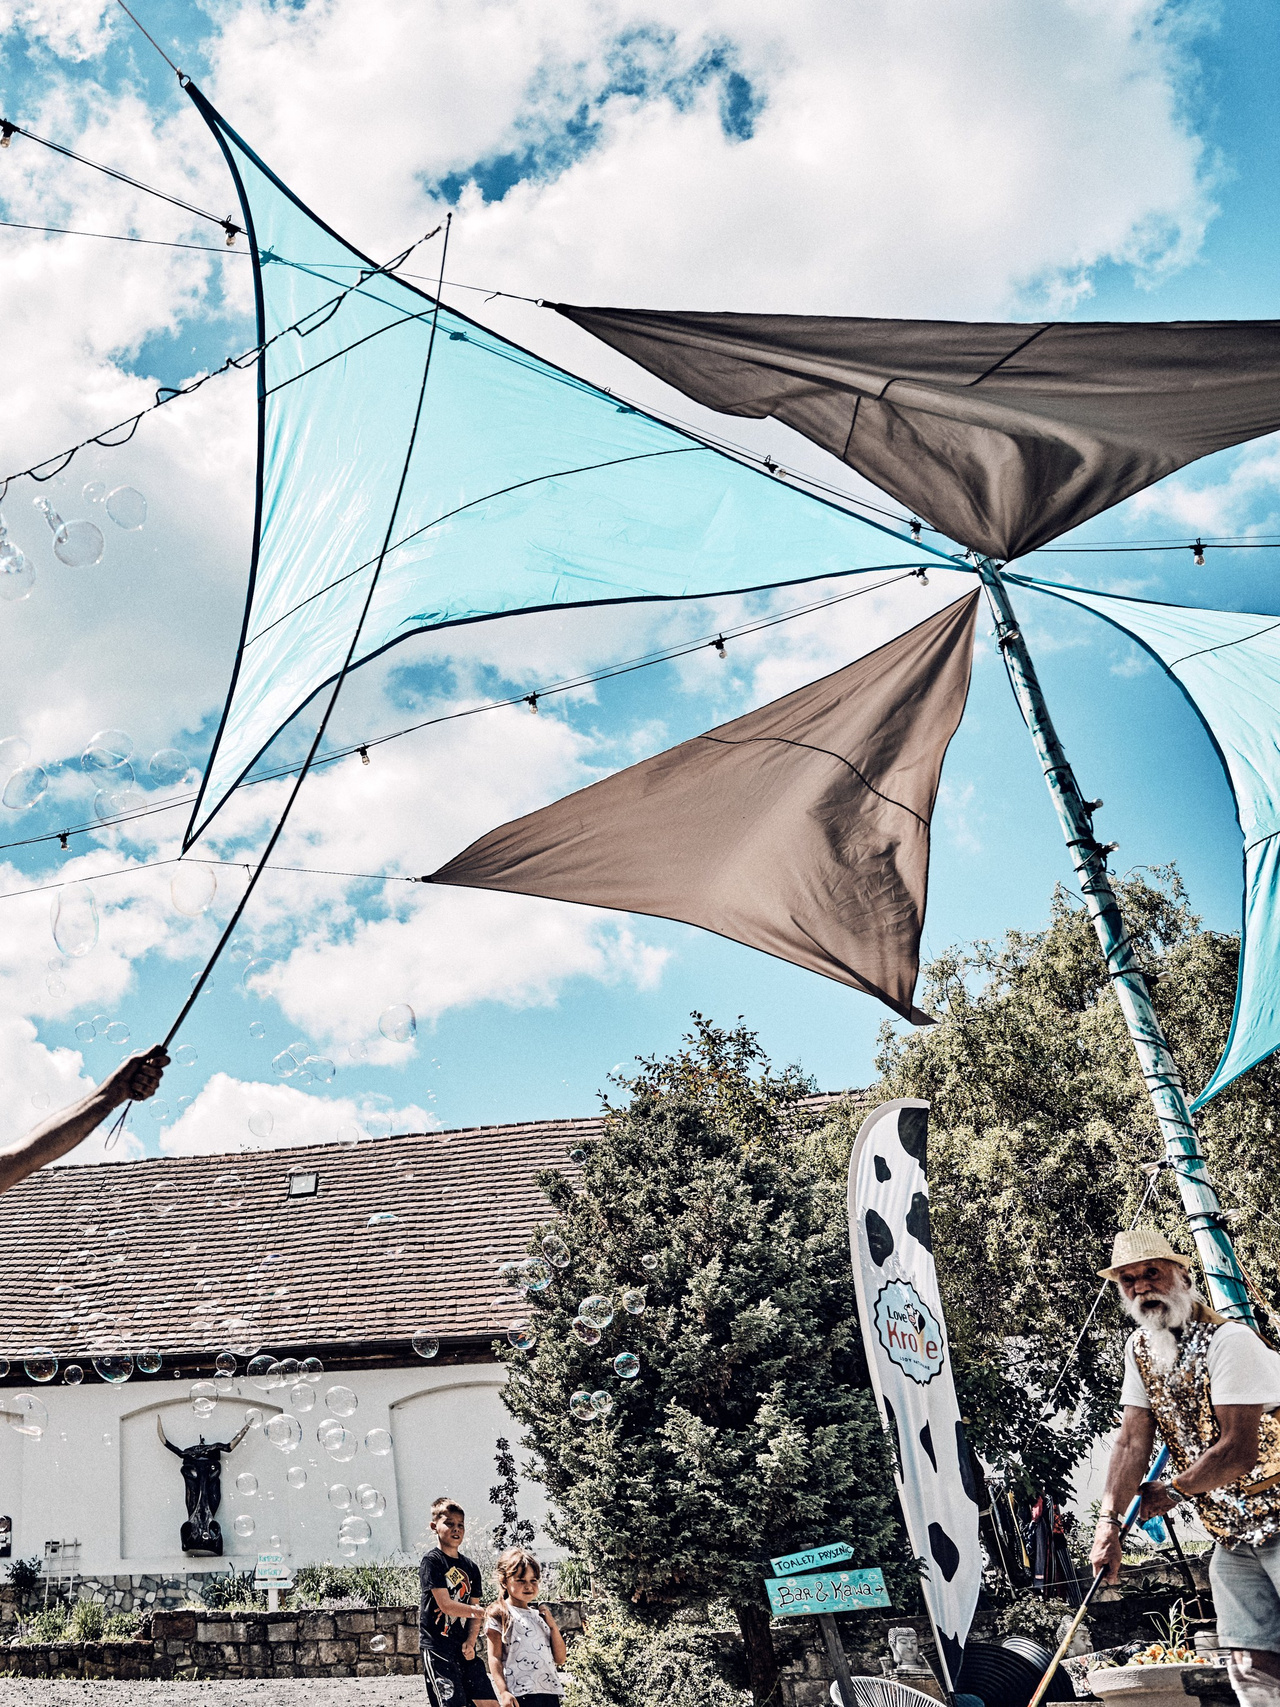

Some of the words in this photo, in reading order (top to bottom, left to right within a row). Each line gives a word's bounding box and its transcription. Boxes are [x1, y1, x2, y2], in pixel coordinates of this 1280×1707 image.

[886, 1305, 908, 1324] Love
[775, 1554, 815, 1571] TOALETY
[815, 1581, 830, 1603] &
